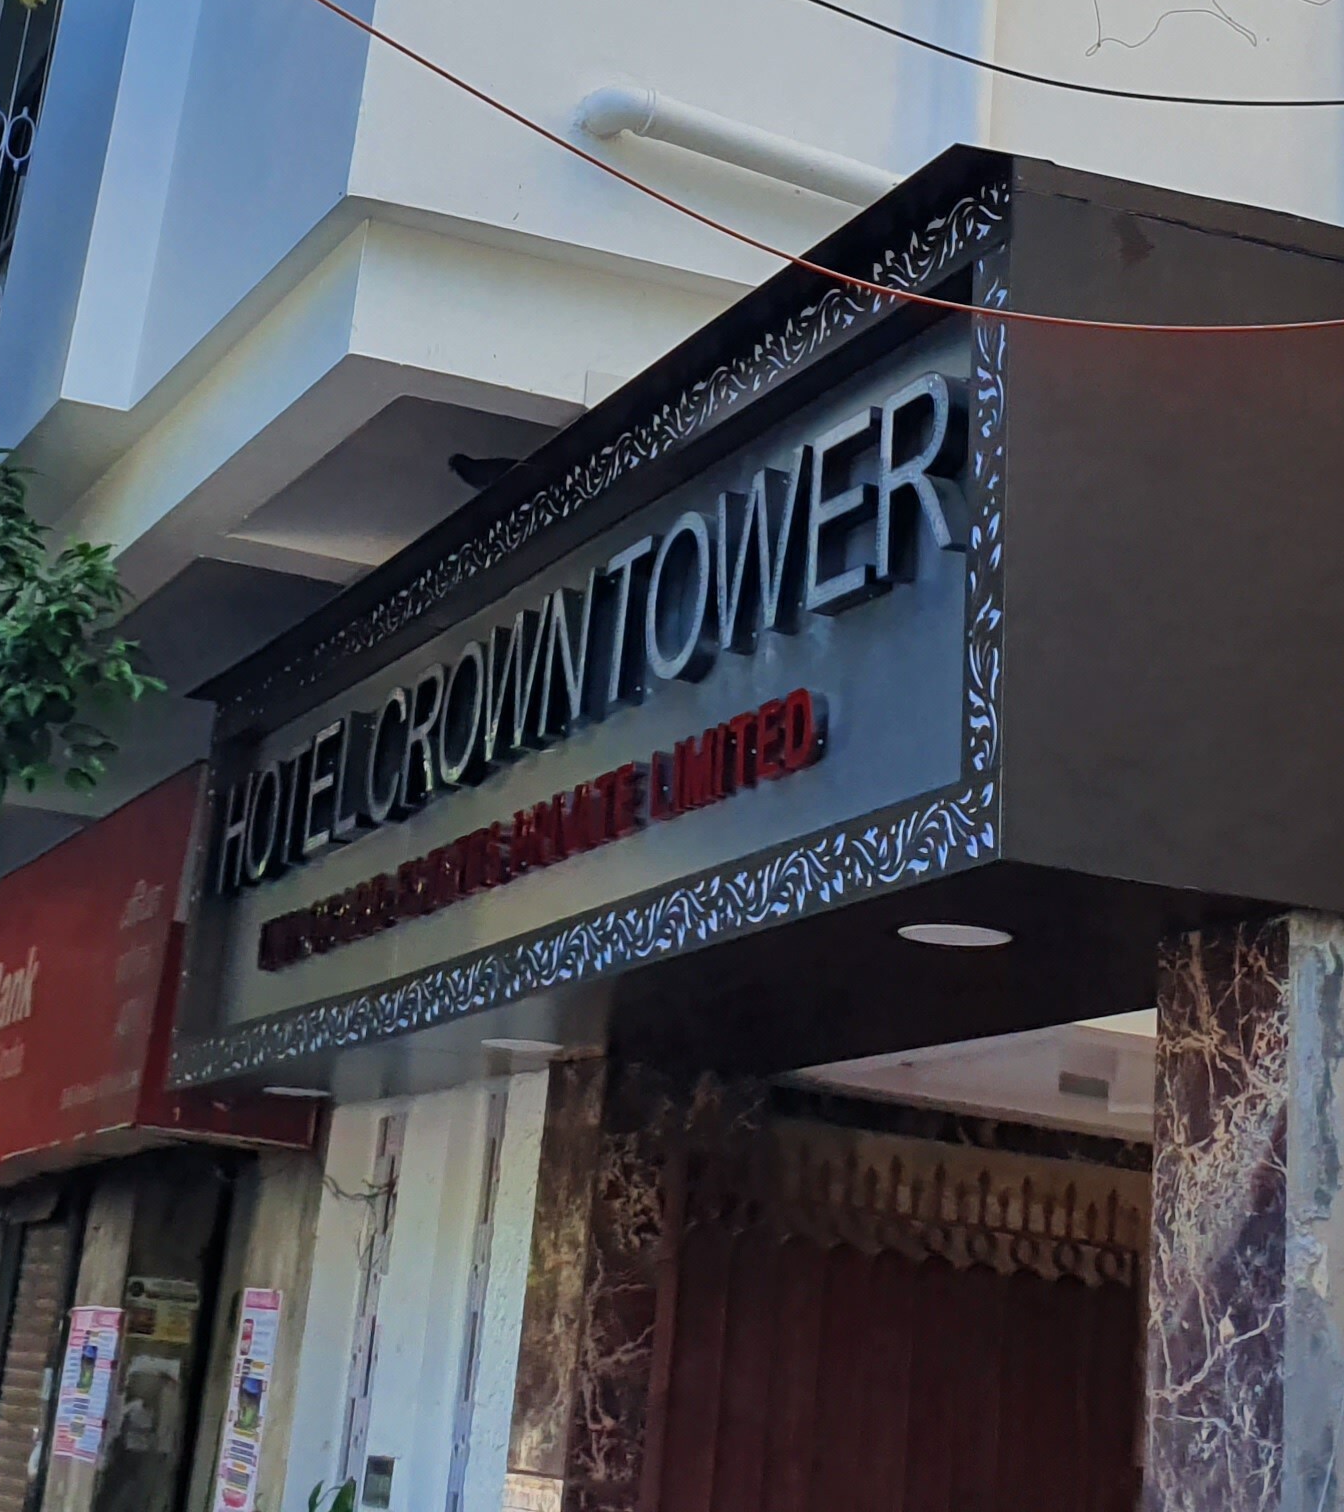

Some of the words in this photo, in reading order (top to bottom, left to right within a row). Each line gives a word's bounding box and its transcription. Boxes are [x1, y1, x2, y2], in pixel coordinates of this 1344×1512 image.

[218, 716, 354, 893] HOTEL
[367, 566, 596, 823] CROWN
[608, 371, 953, 702] TOWER
[650, 687, 814, 821] LIMITED
